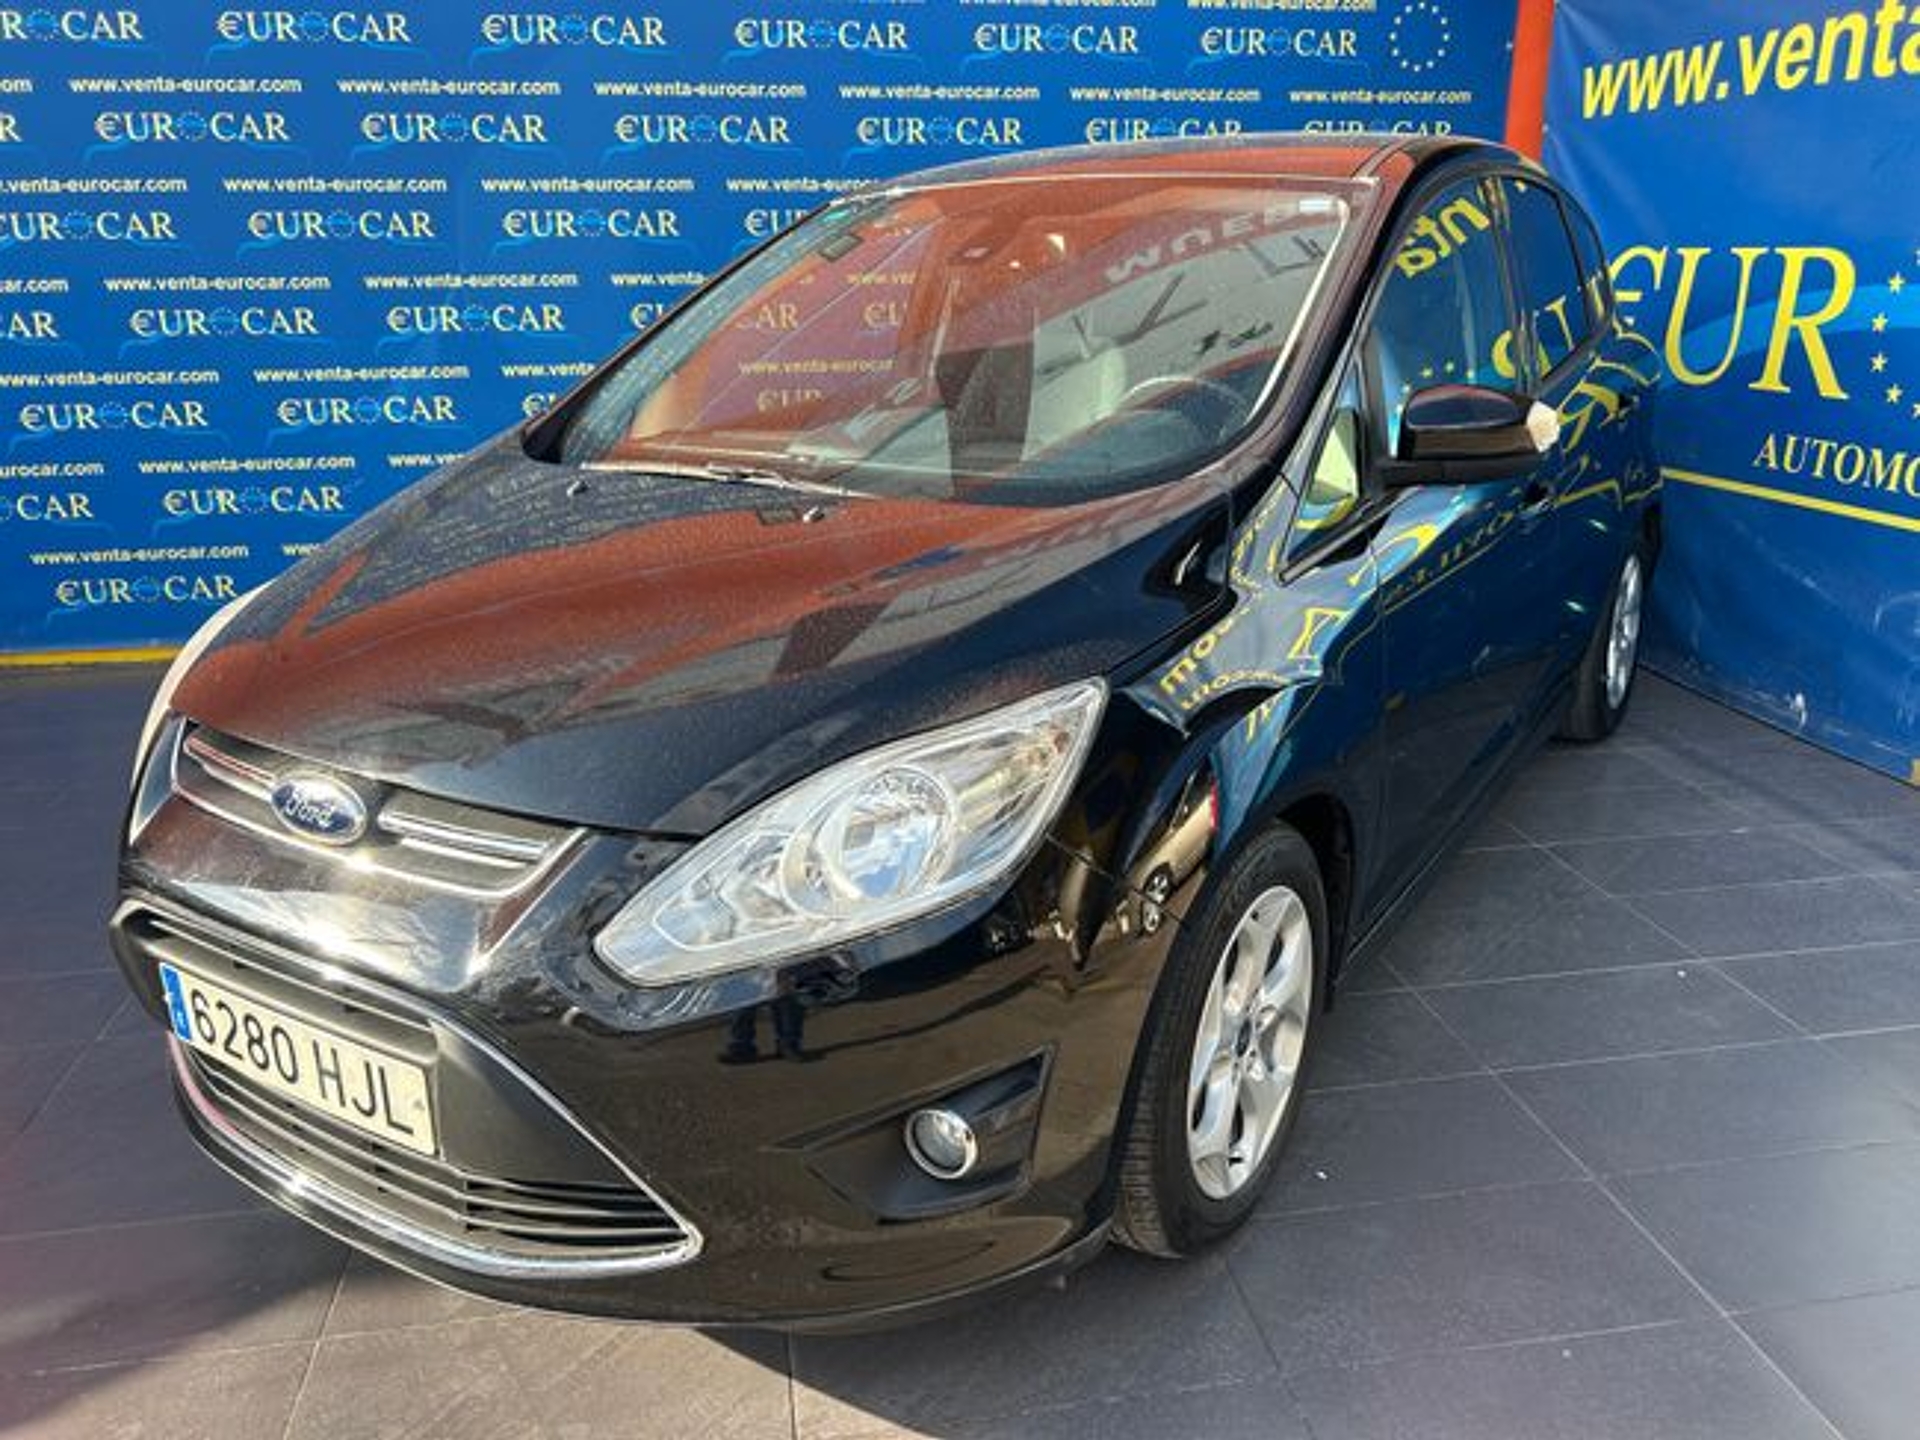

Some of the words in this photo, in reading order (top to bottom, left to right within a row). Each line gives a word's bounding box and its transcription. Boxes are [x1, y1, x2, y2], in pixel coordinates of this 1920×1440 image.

[69, 76, 302, 93] www.venta-eurocar.com
[337, 78, 561, 96] www.venta-eurocar.com
[593, 81, 807, 98] www.venta-eurocar.com
[839, 84, 1040, 100] www.venta-eurocar.com
[1070, 87, 1260, 102] www.venta-eurocar.com
[1290, 89, 1472, 104] www.venta-eurocar.com
[223, 176, 447, 193] www.venta-eurocar.com
[481, 176, 695, 193] www.venta-eurocar.com
[103, 275, 331, 291] www.venta-eurocar.com
[364, 273, 578, 289] www.venta-eurocar.com
[253, 365, 469, 382] www.venta-eurocar.com
[138, 456, 356, 473] www.venta-eurocar.com
[32, 545, 249, 565] www.venta-eurocar.com
[284, 788, 336, 828] Ford
[190, 988, 300, 1085] 6280
[311, 1039, 415, 1136] HJL
